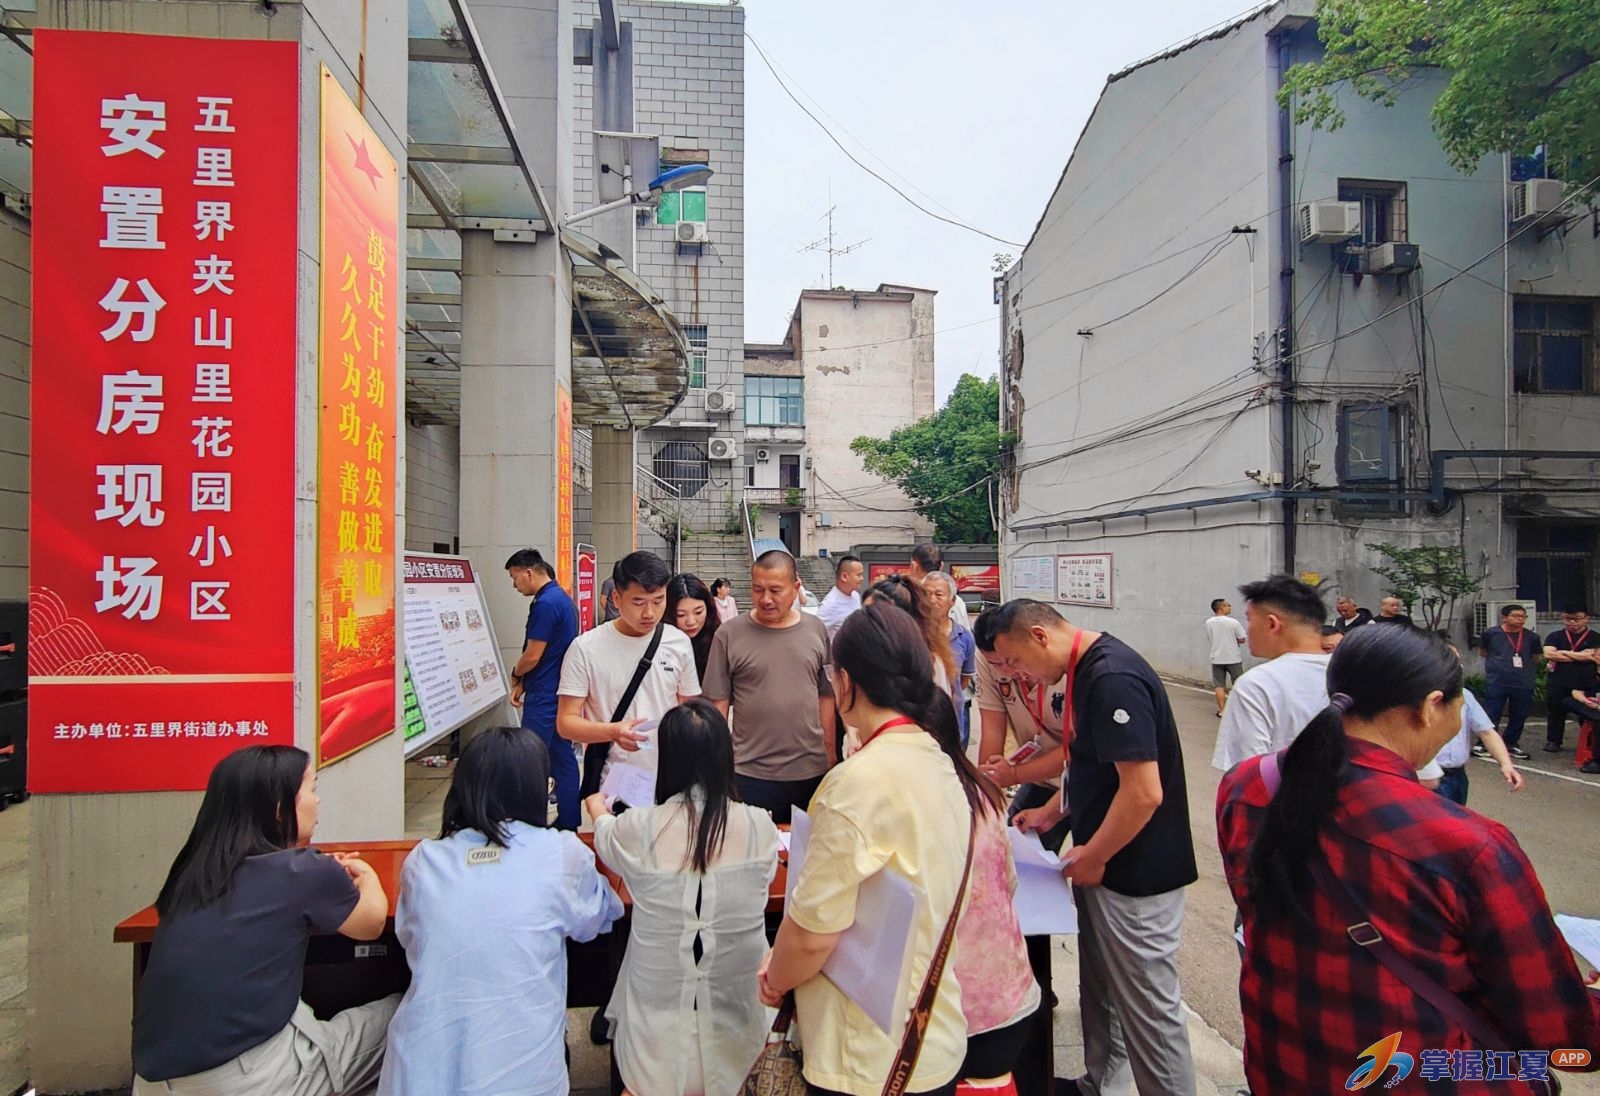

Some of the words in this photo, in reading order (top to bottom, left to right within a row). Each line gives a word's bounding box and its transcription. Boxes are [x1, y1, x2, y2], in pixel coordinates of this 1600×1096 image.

[95, 94, 166, 620] 安置分房现场
[190, 96, 236, 620] 五里界夹山里花园小区
[339, 252, 362, 446] 久久为功
[367, 227, 385, 408] 鼓足干劲
[337, 460, 360, 653] 善做善成
[364, 422, 385, 598] 奋发进取
[54, 720, 269, 739] 主办单位：五里界街道办事处
